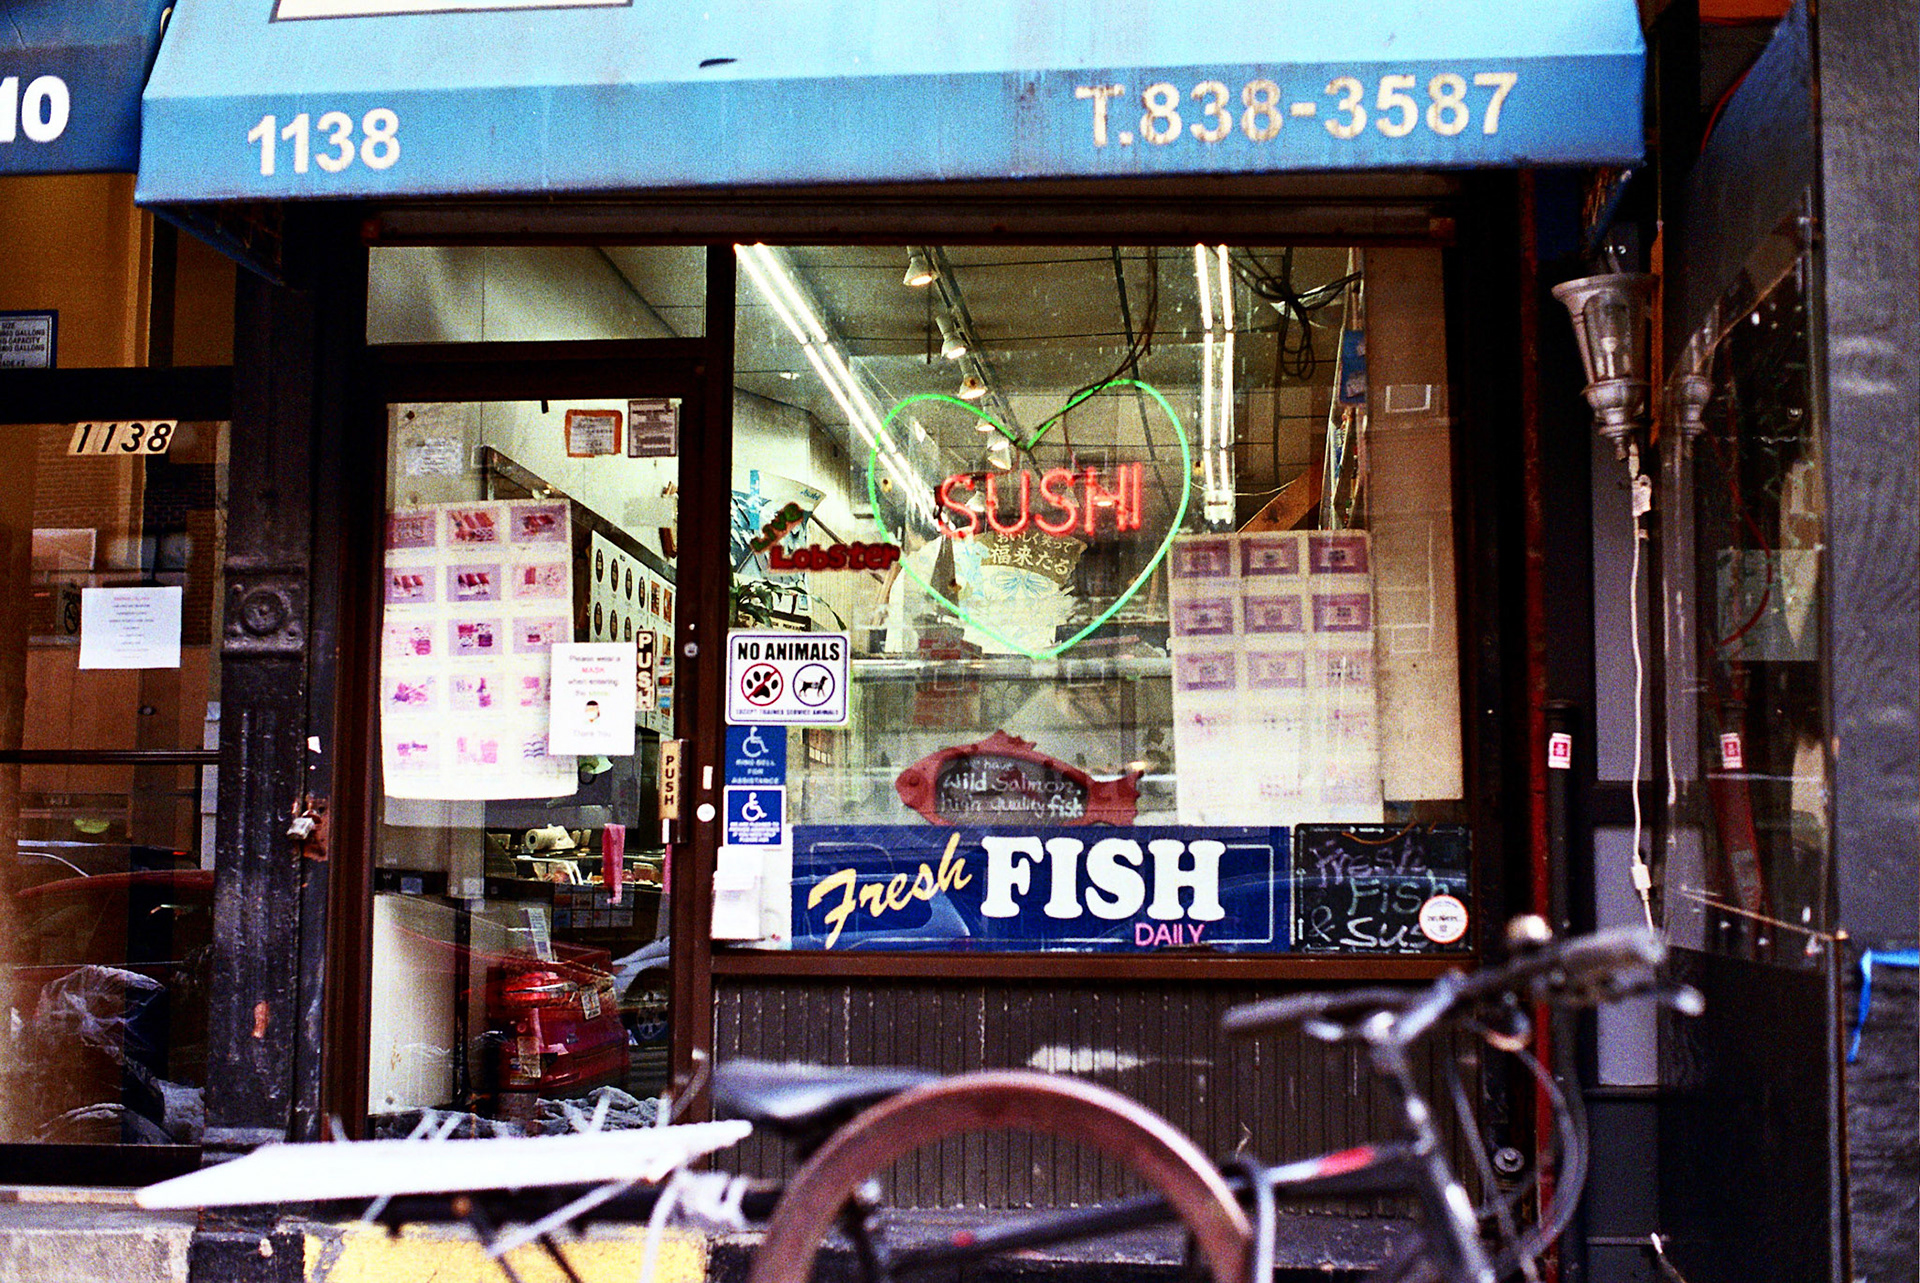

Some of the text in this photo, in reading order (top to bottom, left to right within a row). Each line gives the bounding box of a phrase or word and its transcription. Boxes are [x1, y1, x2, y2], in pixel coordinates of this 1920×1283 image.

[1075, 72, 1518, 147] T.838-3587
[247, 108, 401, 177] 1138
[14, 344, 45, 352] GALLONS
[15, 329, 45, 337] GALLONS
[76, 423, 172, 453] 1138
[937, 461, 1143, 539] SUSHI
[989, 543, 1071, 576] 福来たる
[636, 633, 653, 709] PUSH
[737, 643, 840, 661] NO ANIMALS
[664, 755, 675, 806] PUSH
[807, 832, 972, 950] Fresh
[980, 836, 1227, 922] FISH
[1347, 868, 1450, 916] Fish
